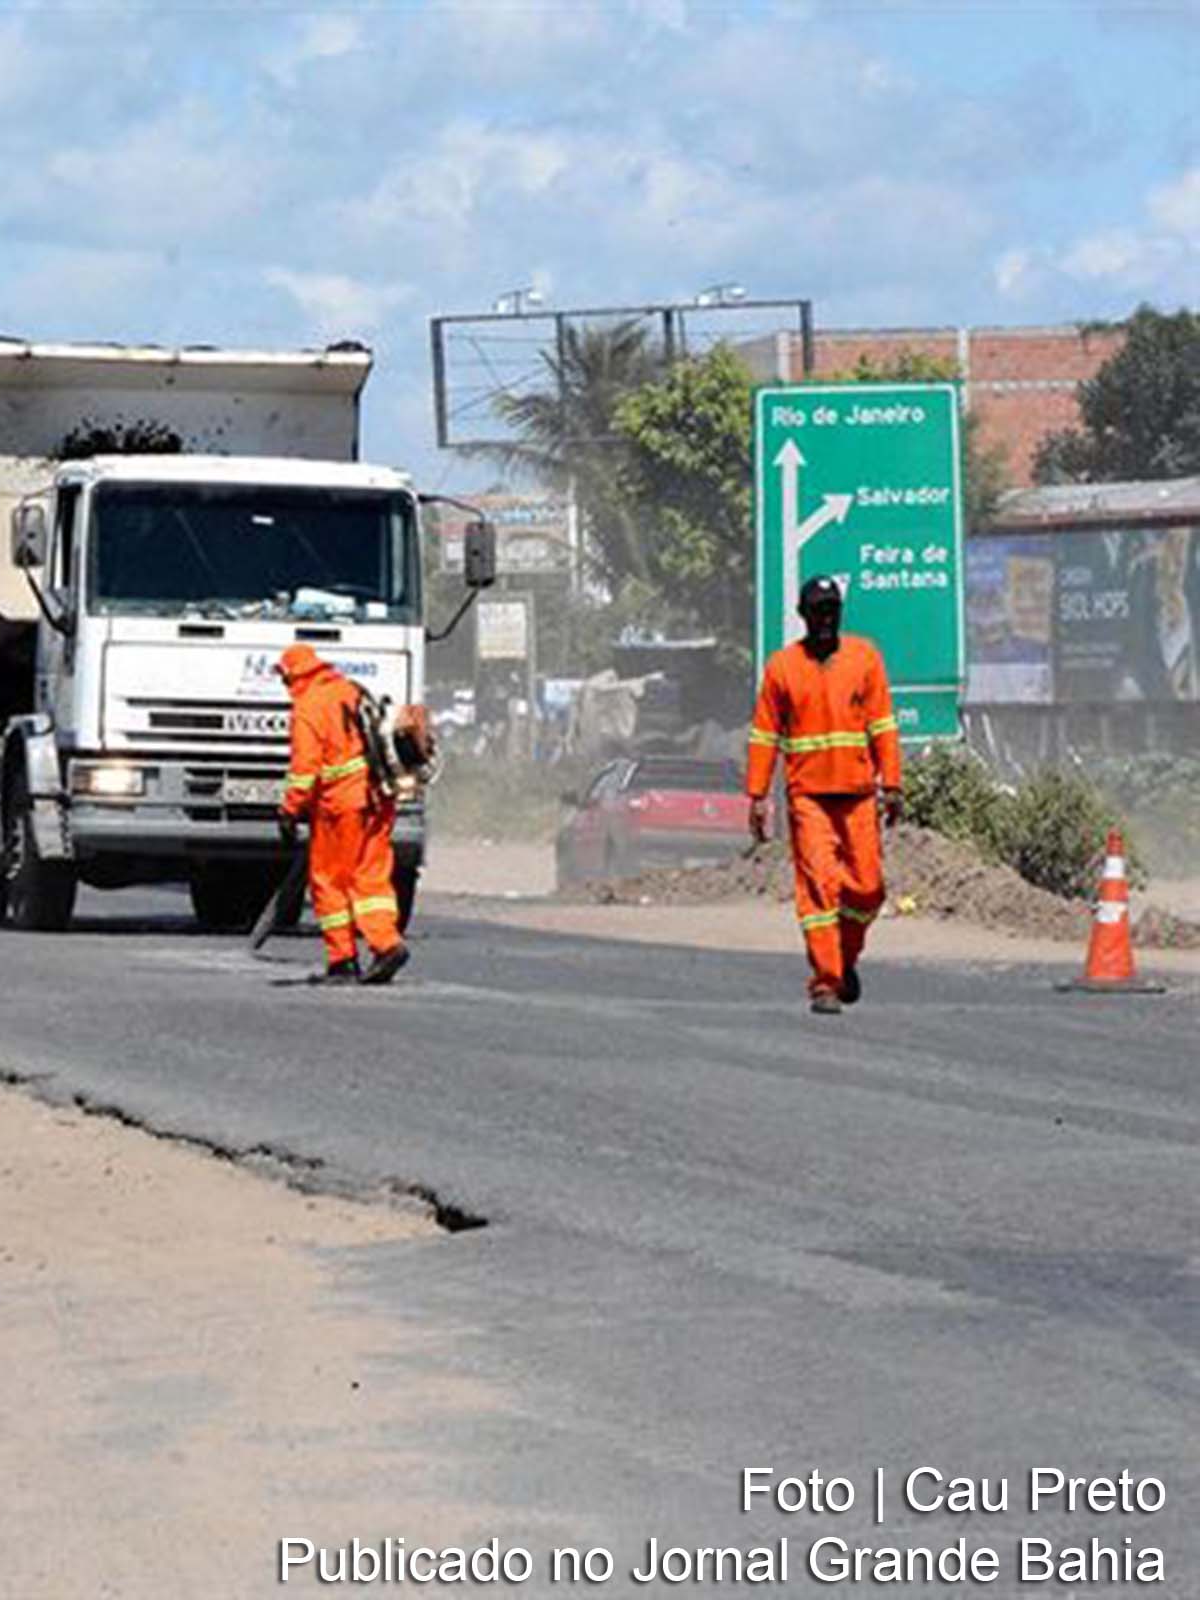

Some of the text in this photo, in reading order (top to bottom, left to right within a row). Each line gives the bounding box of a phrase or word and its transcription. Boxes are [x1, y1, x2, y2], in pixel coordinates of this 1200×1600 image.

[772, 404, 926, 427] Rio de Janeiro
[856, 486, 950, 506] Salvador
[860, 543, 947, 564] Feira de
[860, 569, 948, 590] Santana
